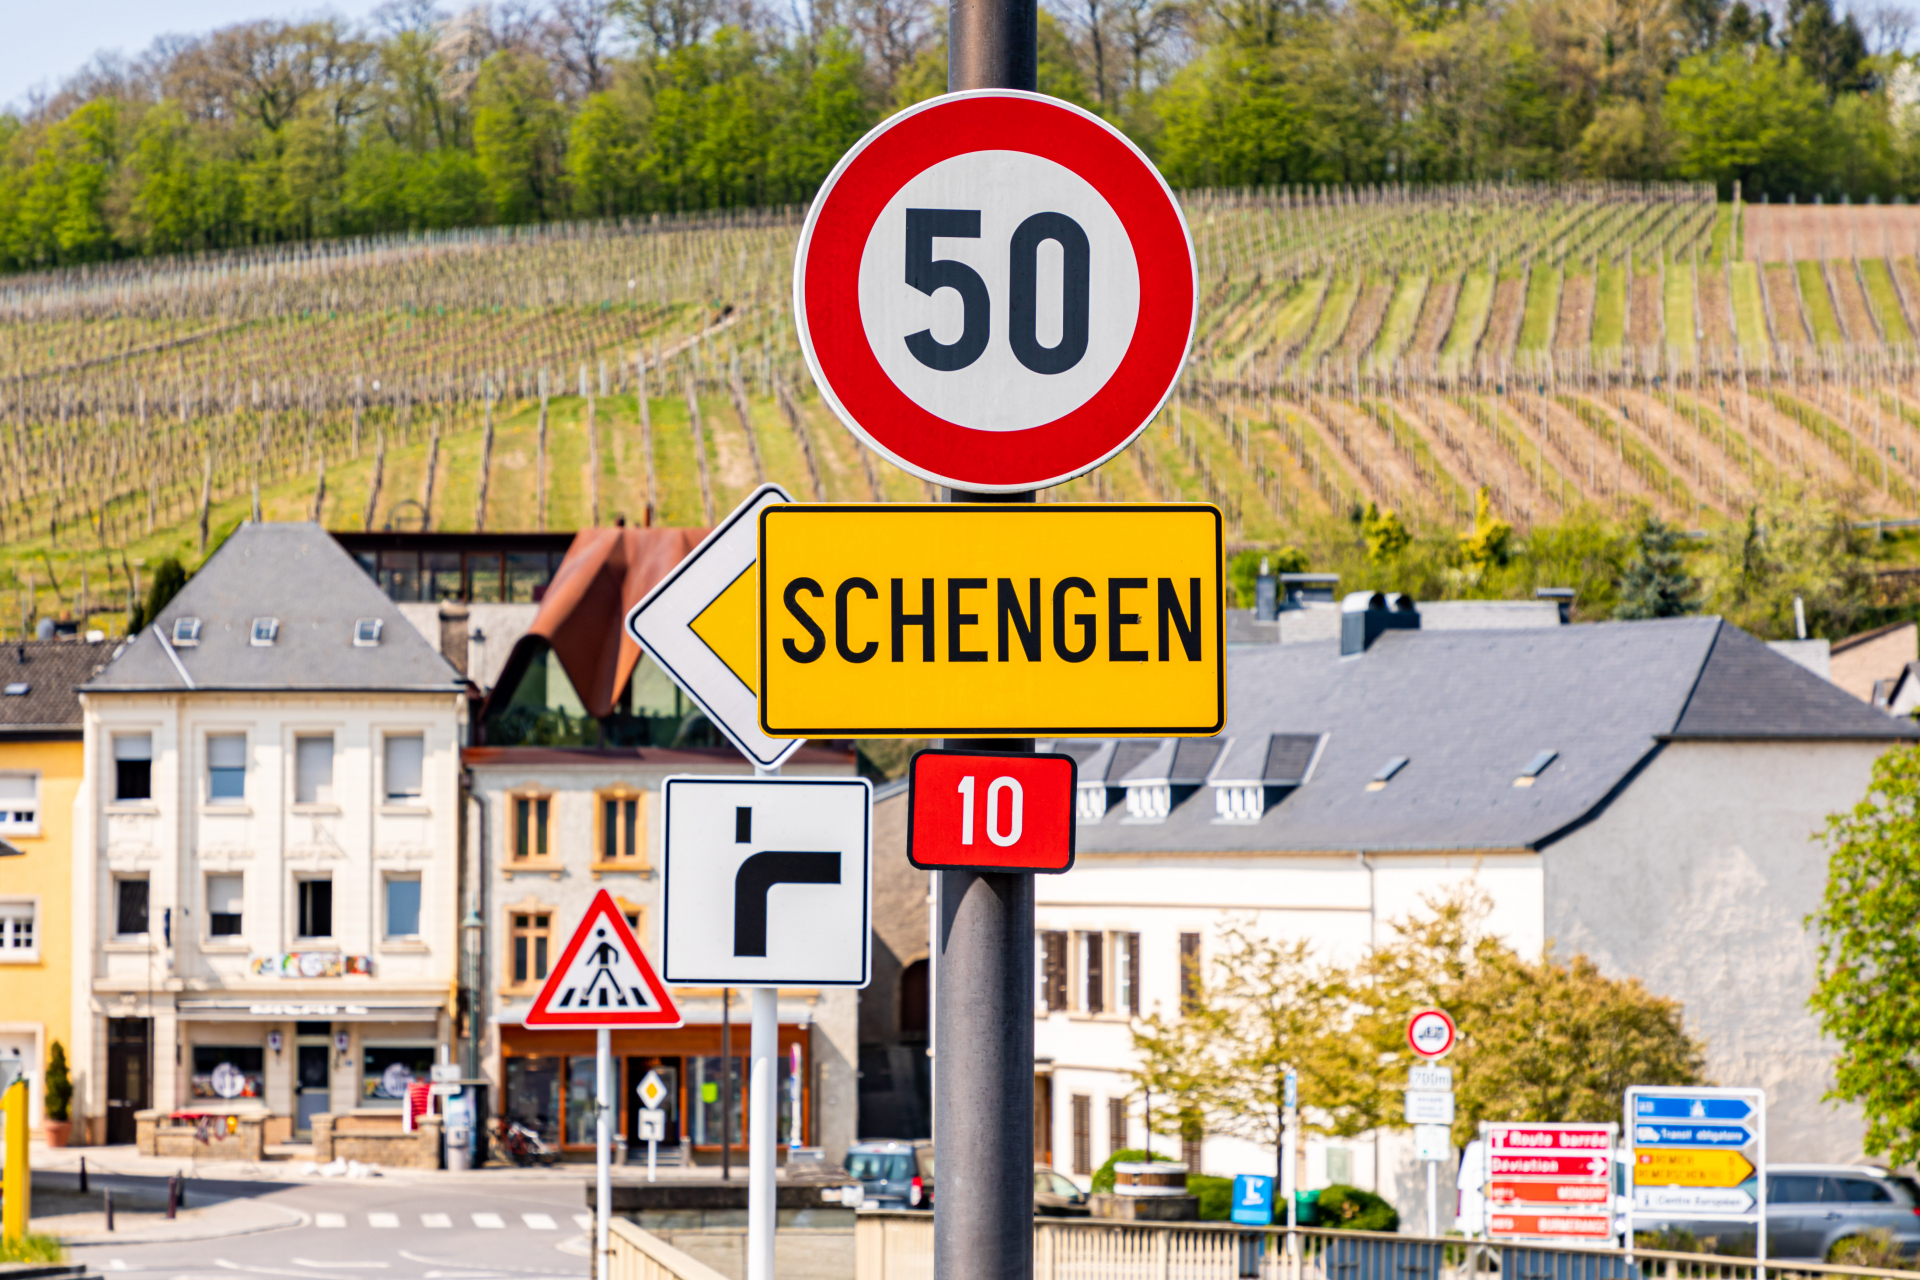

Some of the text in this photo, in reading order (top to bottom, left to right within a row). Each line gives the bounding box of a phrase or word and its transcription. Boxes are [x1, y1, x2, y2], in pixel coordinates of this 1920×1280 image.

[904, 208, 1091, 375] 50
[782, 576, 1202, 664] SCHENGEN
[957, 775, 1024, 847] 10
[1509, 1130, 1608, 1148] Route barrée
[1660, 1127, 1743, 1143] Transit obligatoire
[1492, 1157, 1559, 1173] Déviation
[1656, 1155, 1694, 1164] REMICH
[1638, 1169, 1706, 1179] REMERSCHEN
[1556, 1185, 1606, 1201] MONDORF
[1658, 1194, 1690, 1205] Centre
[1537, 1217, 1607, 1233] BURMERANGE
